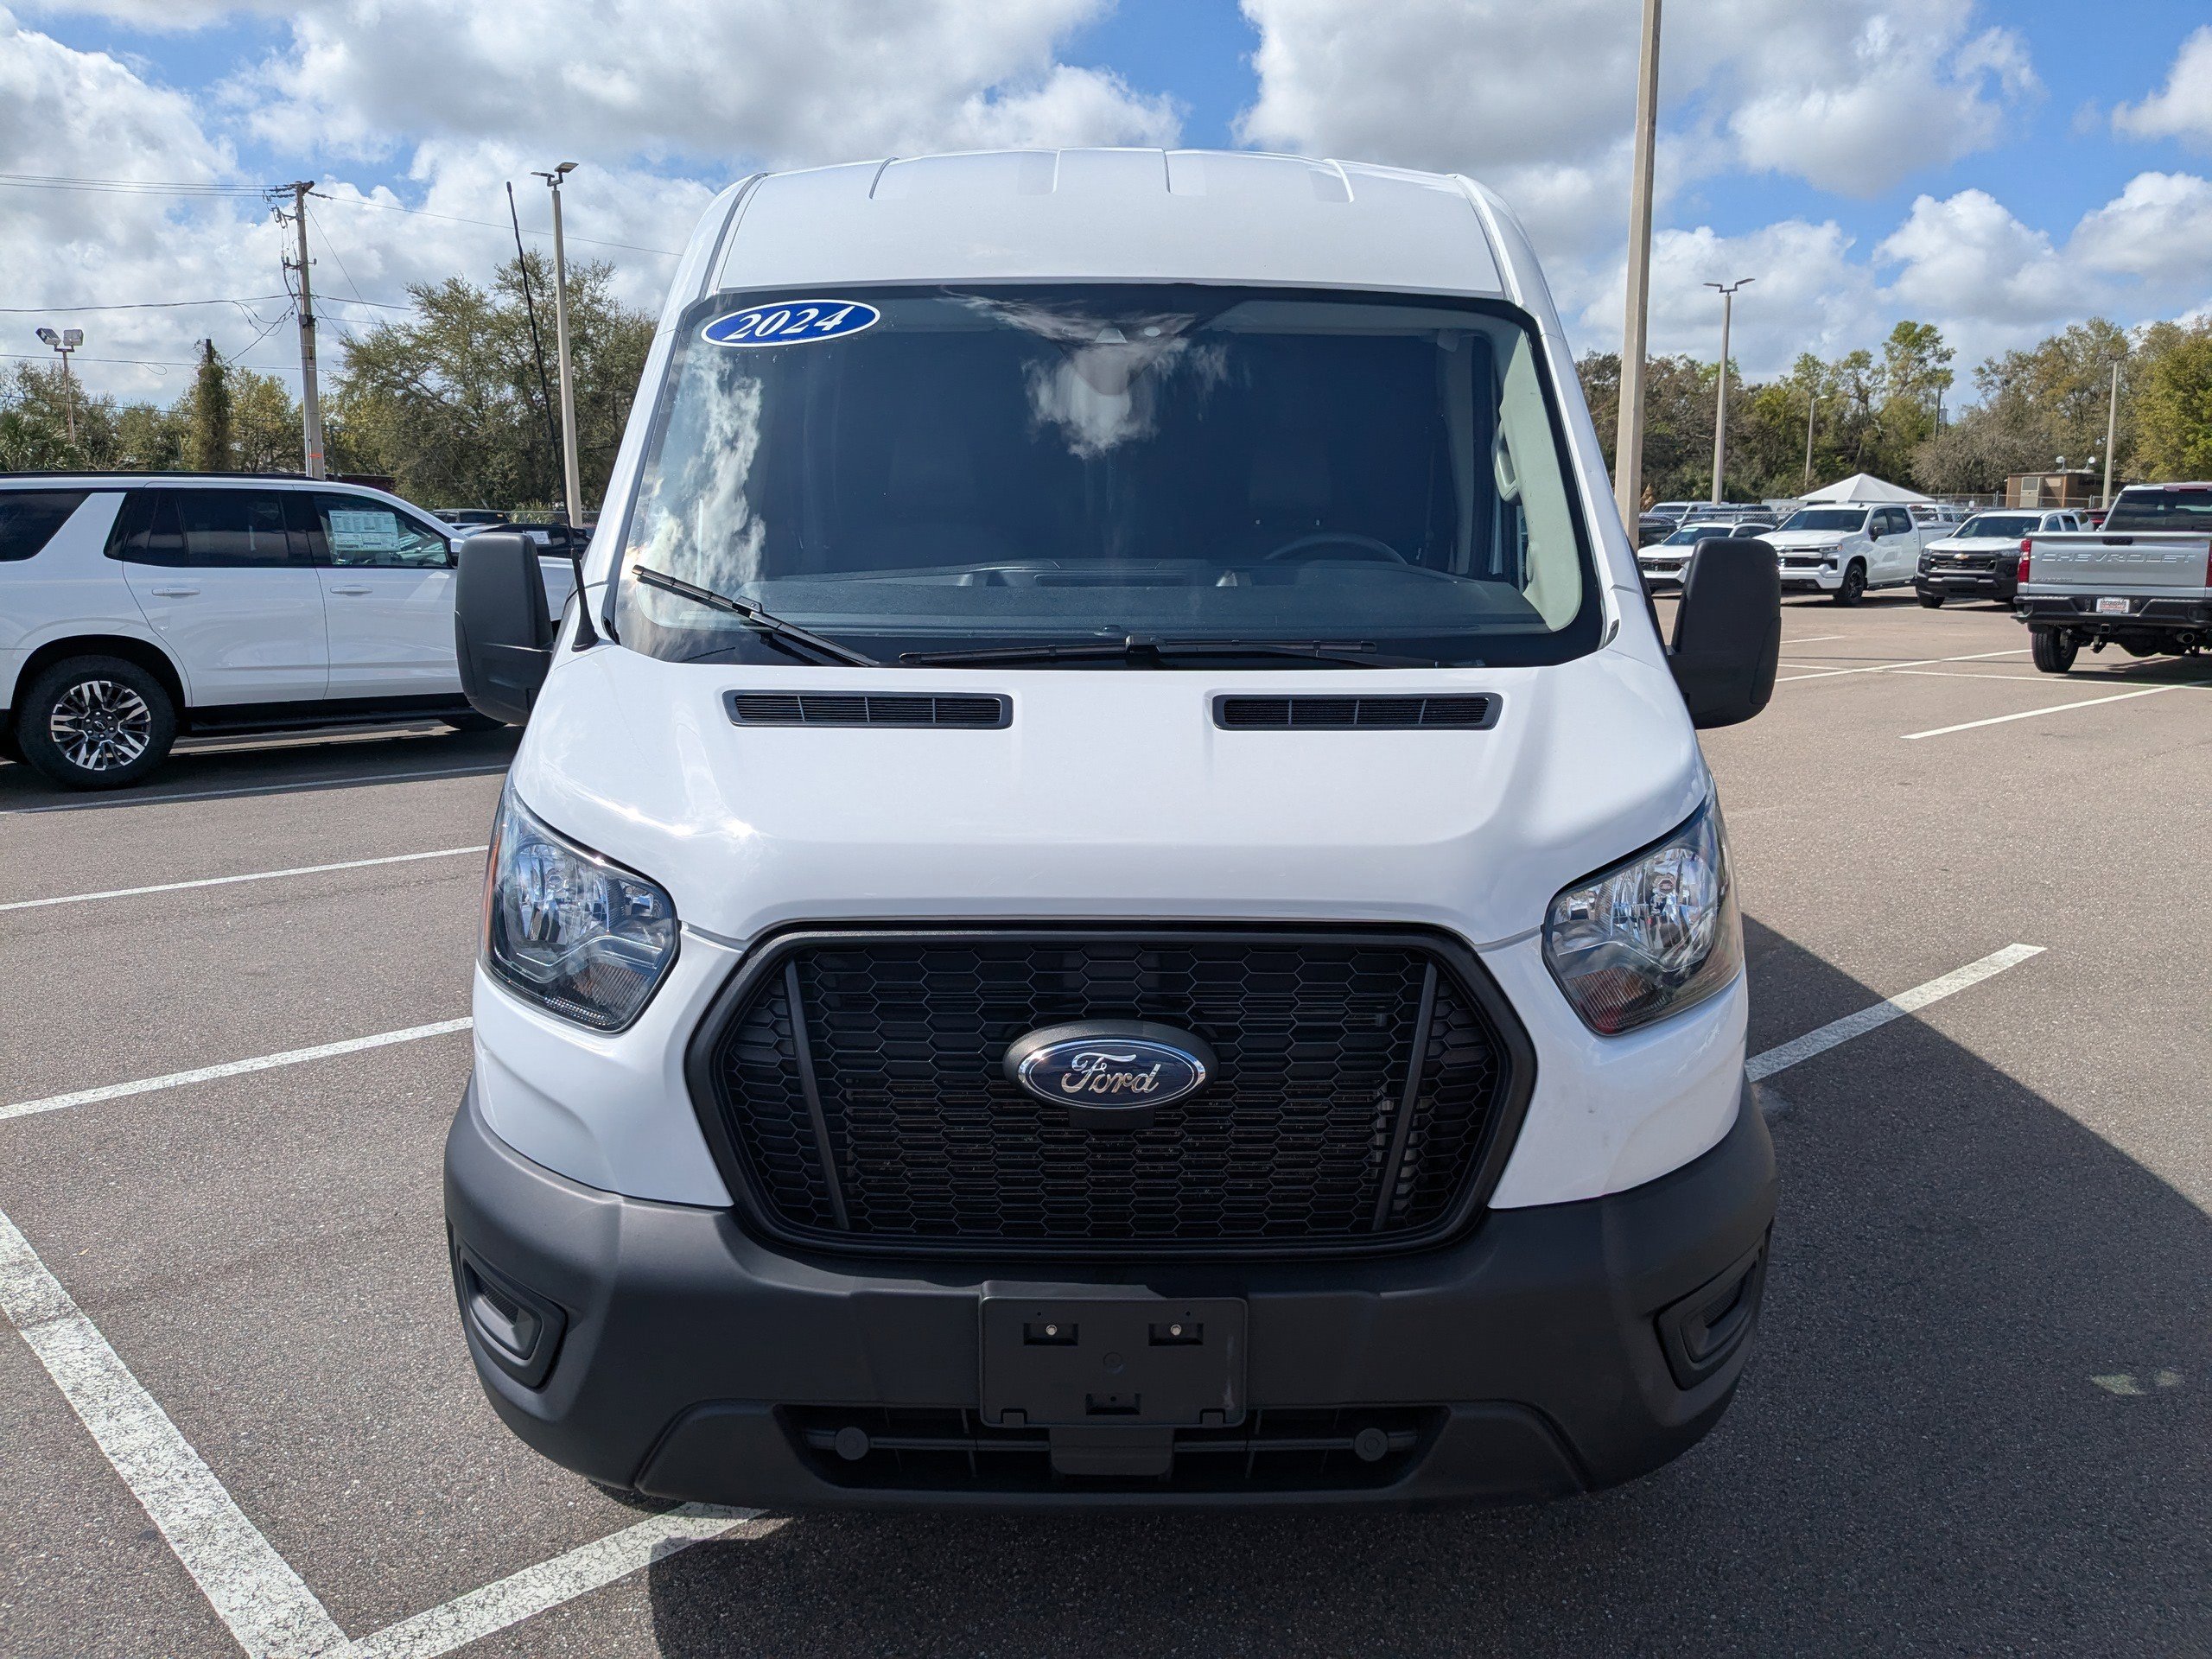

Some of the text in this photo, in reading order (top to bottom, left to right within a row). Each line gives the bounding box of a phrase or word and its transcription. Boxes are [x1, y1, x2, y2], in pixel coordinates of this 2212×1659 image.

[721, 305, 855, 341] 2024
[2041, 553, 2196, 563] CHEVROLET
[1061, 1052, 1161, 1094] Ford
